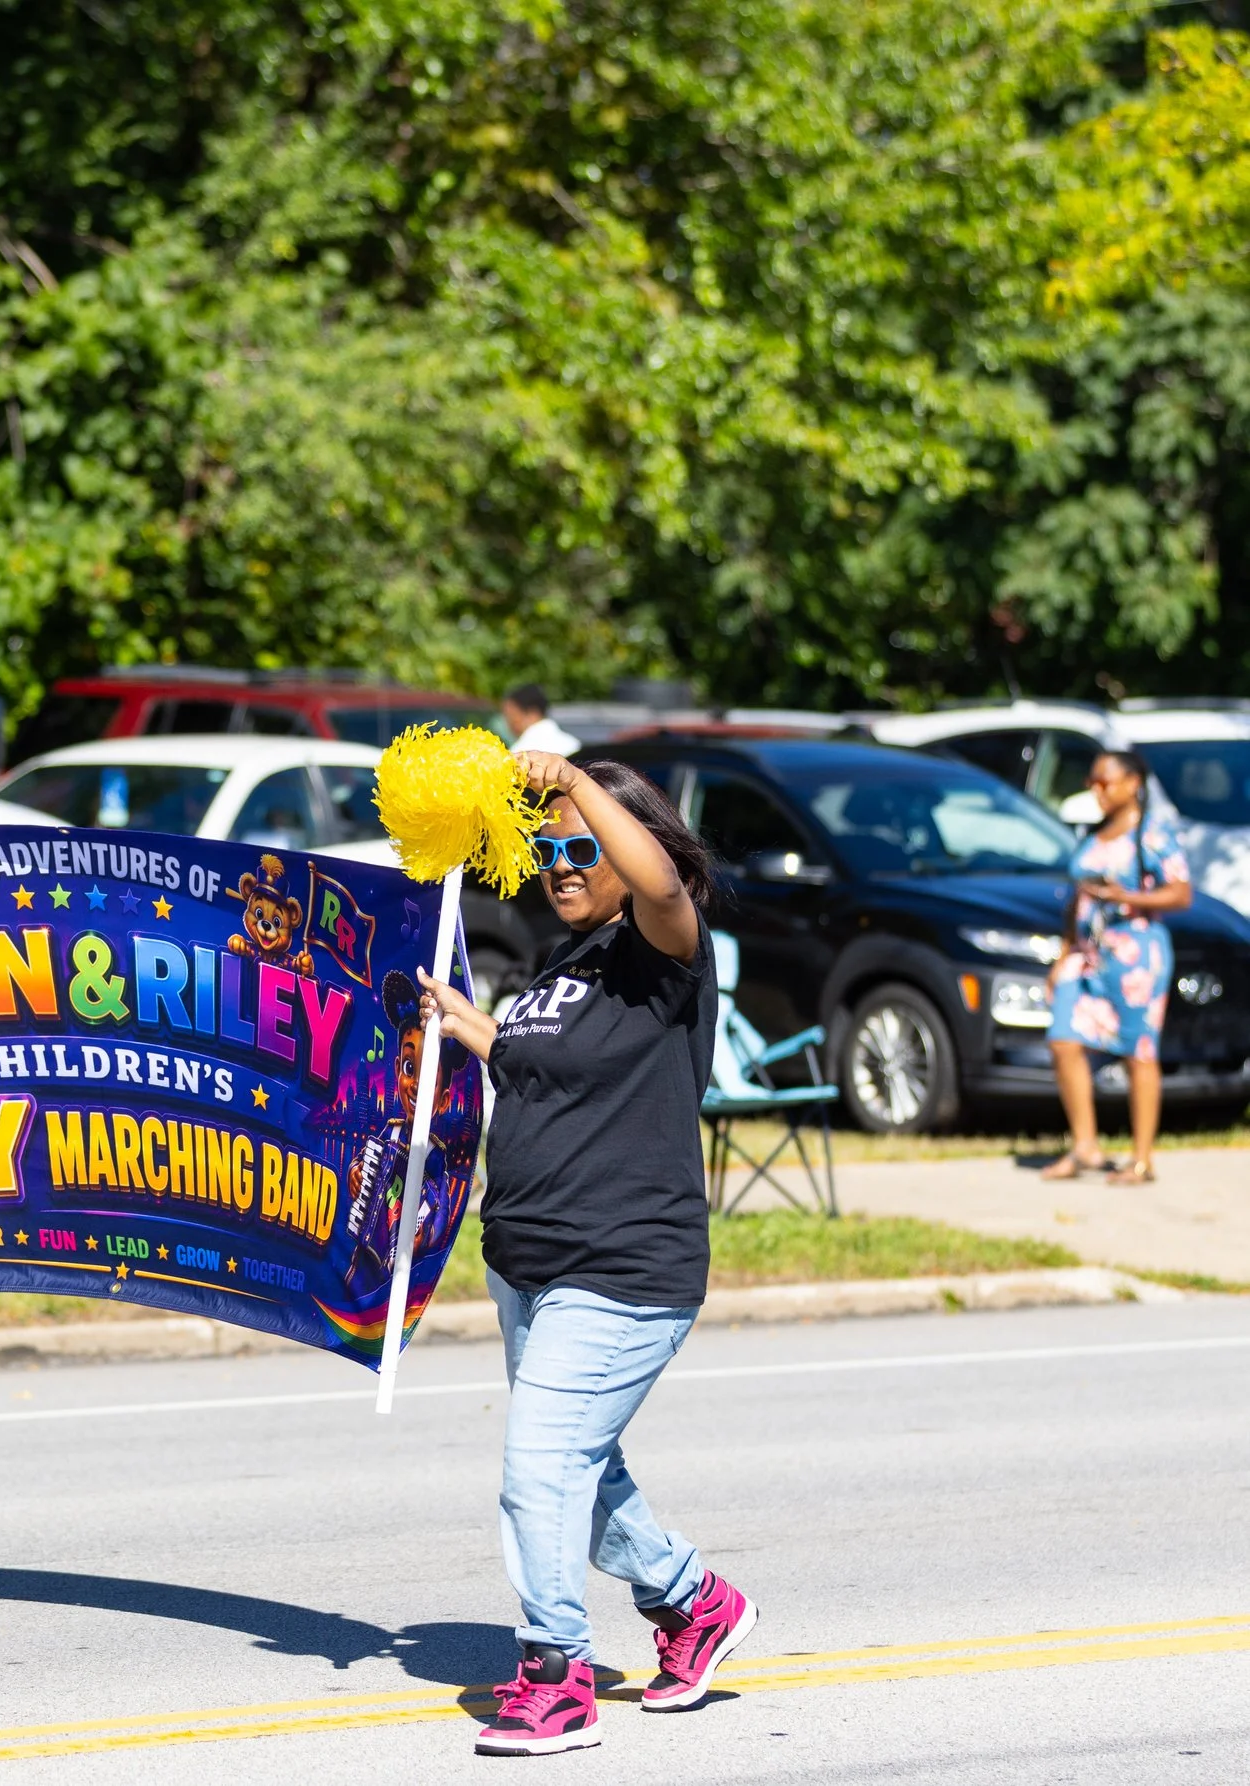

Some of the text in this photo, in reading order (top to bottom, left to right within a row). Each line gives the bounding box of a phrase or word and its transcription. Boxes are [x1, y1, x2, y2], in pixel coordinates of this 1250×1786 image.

[188, 864, 221, 902] OF
[70, 934, 127, 1023] &
[134, 937, 350, 1081] RILEY
[528, 1023, 562, 1035] Parent)
[45, 1110, 339, 1245] MARCHING BAND
[39, 1229, 76, 1251] FUN
[107, 1234, 149, 1259] LEAD
[176, 1244, 220, 1271] GROW
[243, 1257, 306, 1293] TOGETHER
